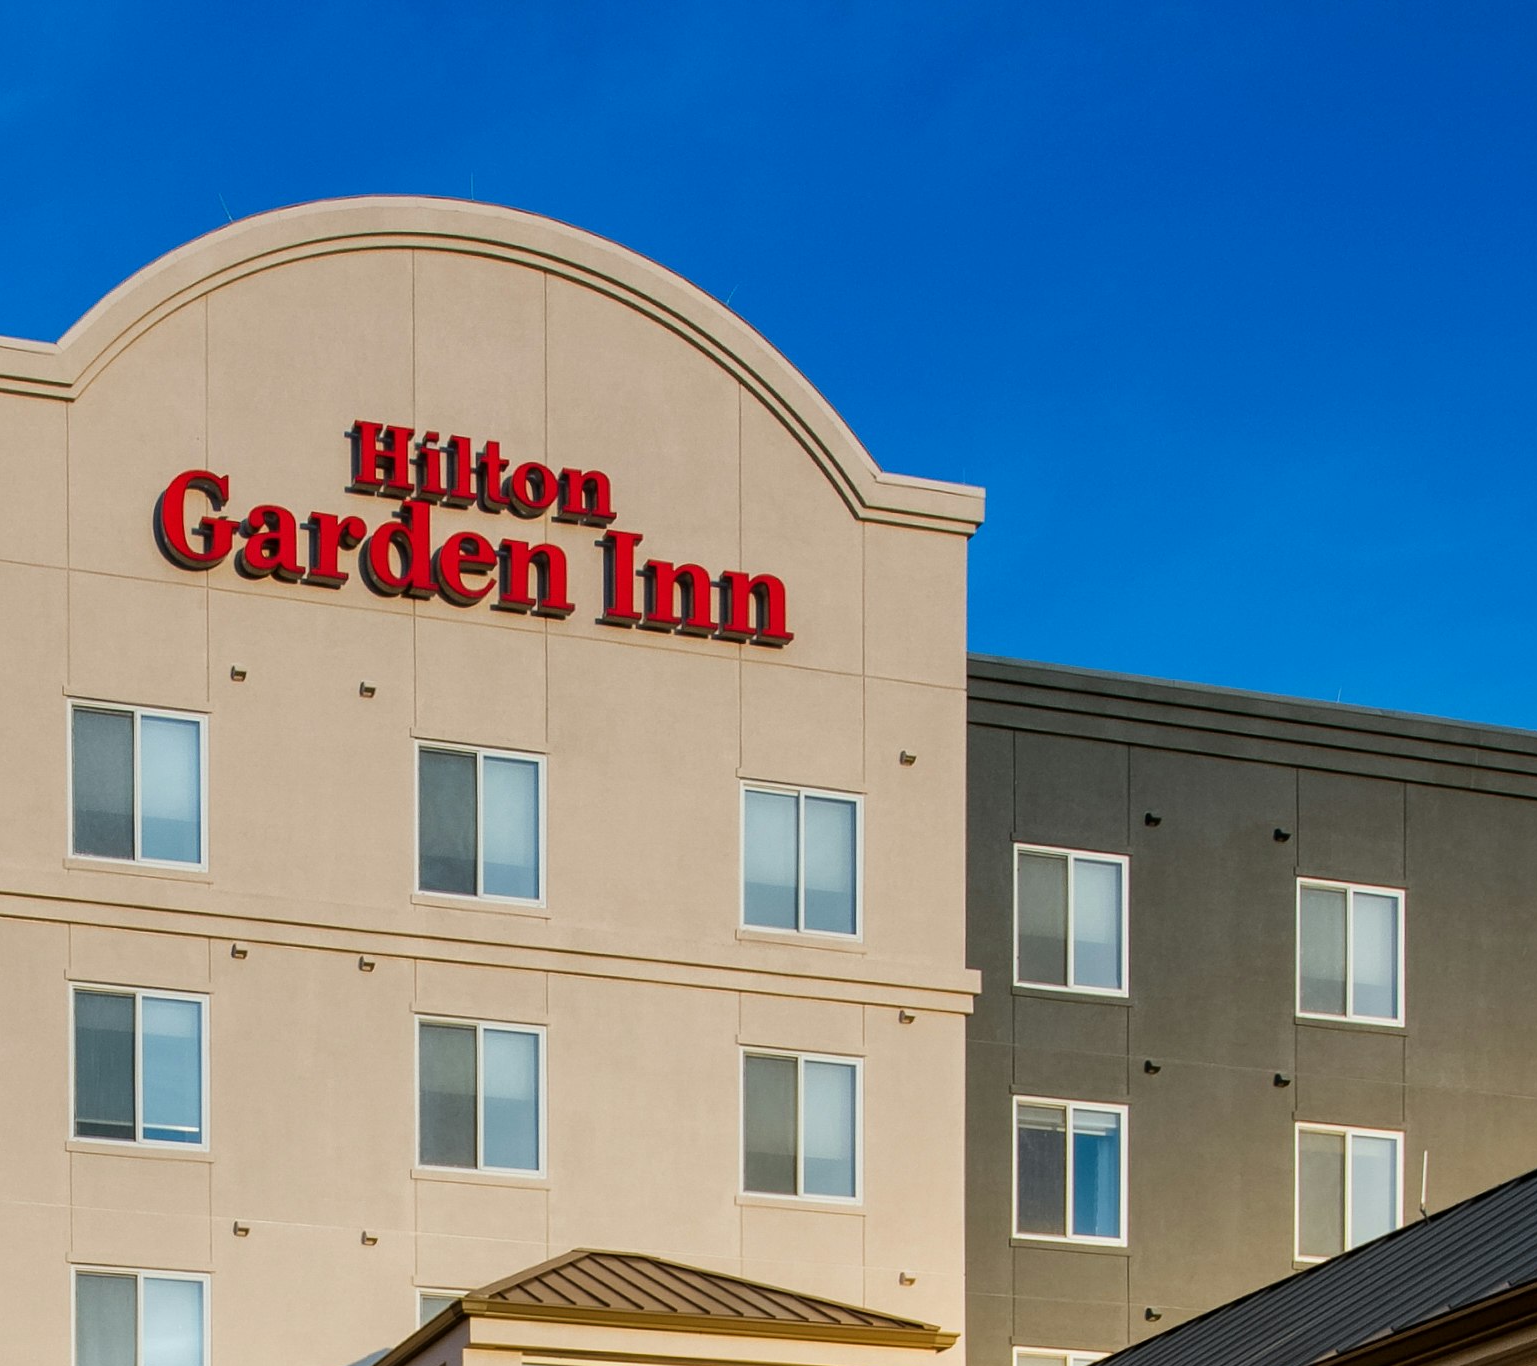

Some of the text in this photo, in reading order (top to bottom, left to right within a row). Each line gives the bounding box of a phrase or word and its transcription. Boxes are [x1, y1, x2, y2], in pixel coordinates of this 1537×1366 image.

[350, 420, 615, 524] Hilton
[157, 469, 794, 645] Garden Inn
